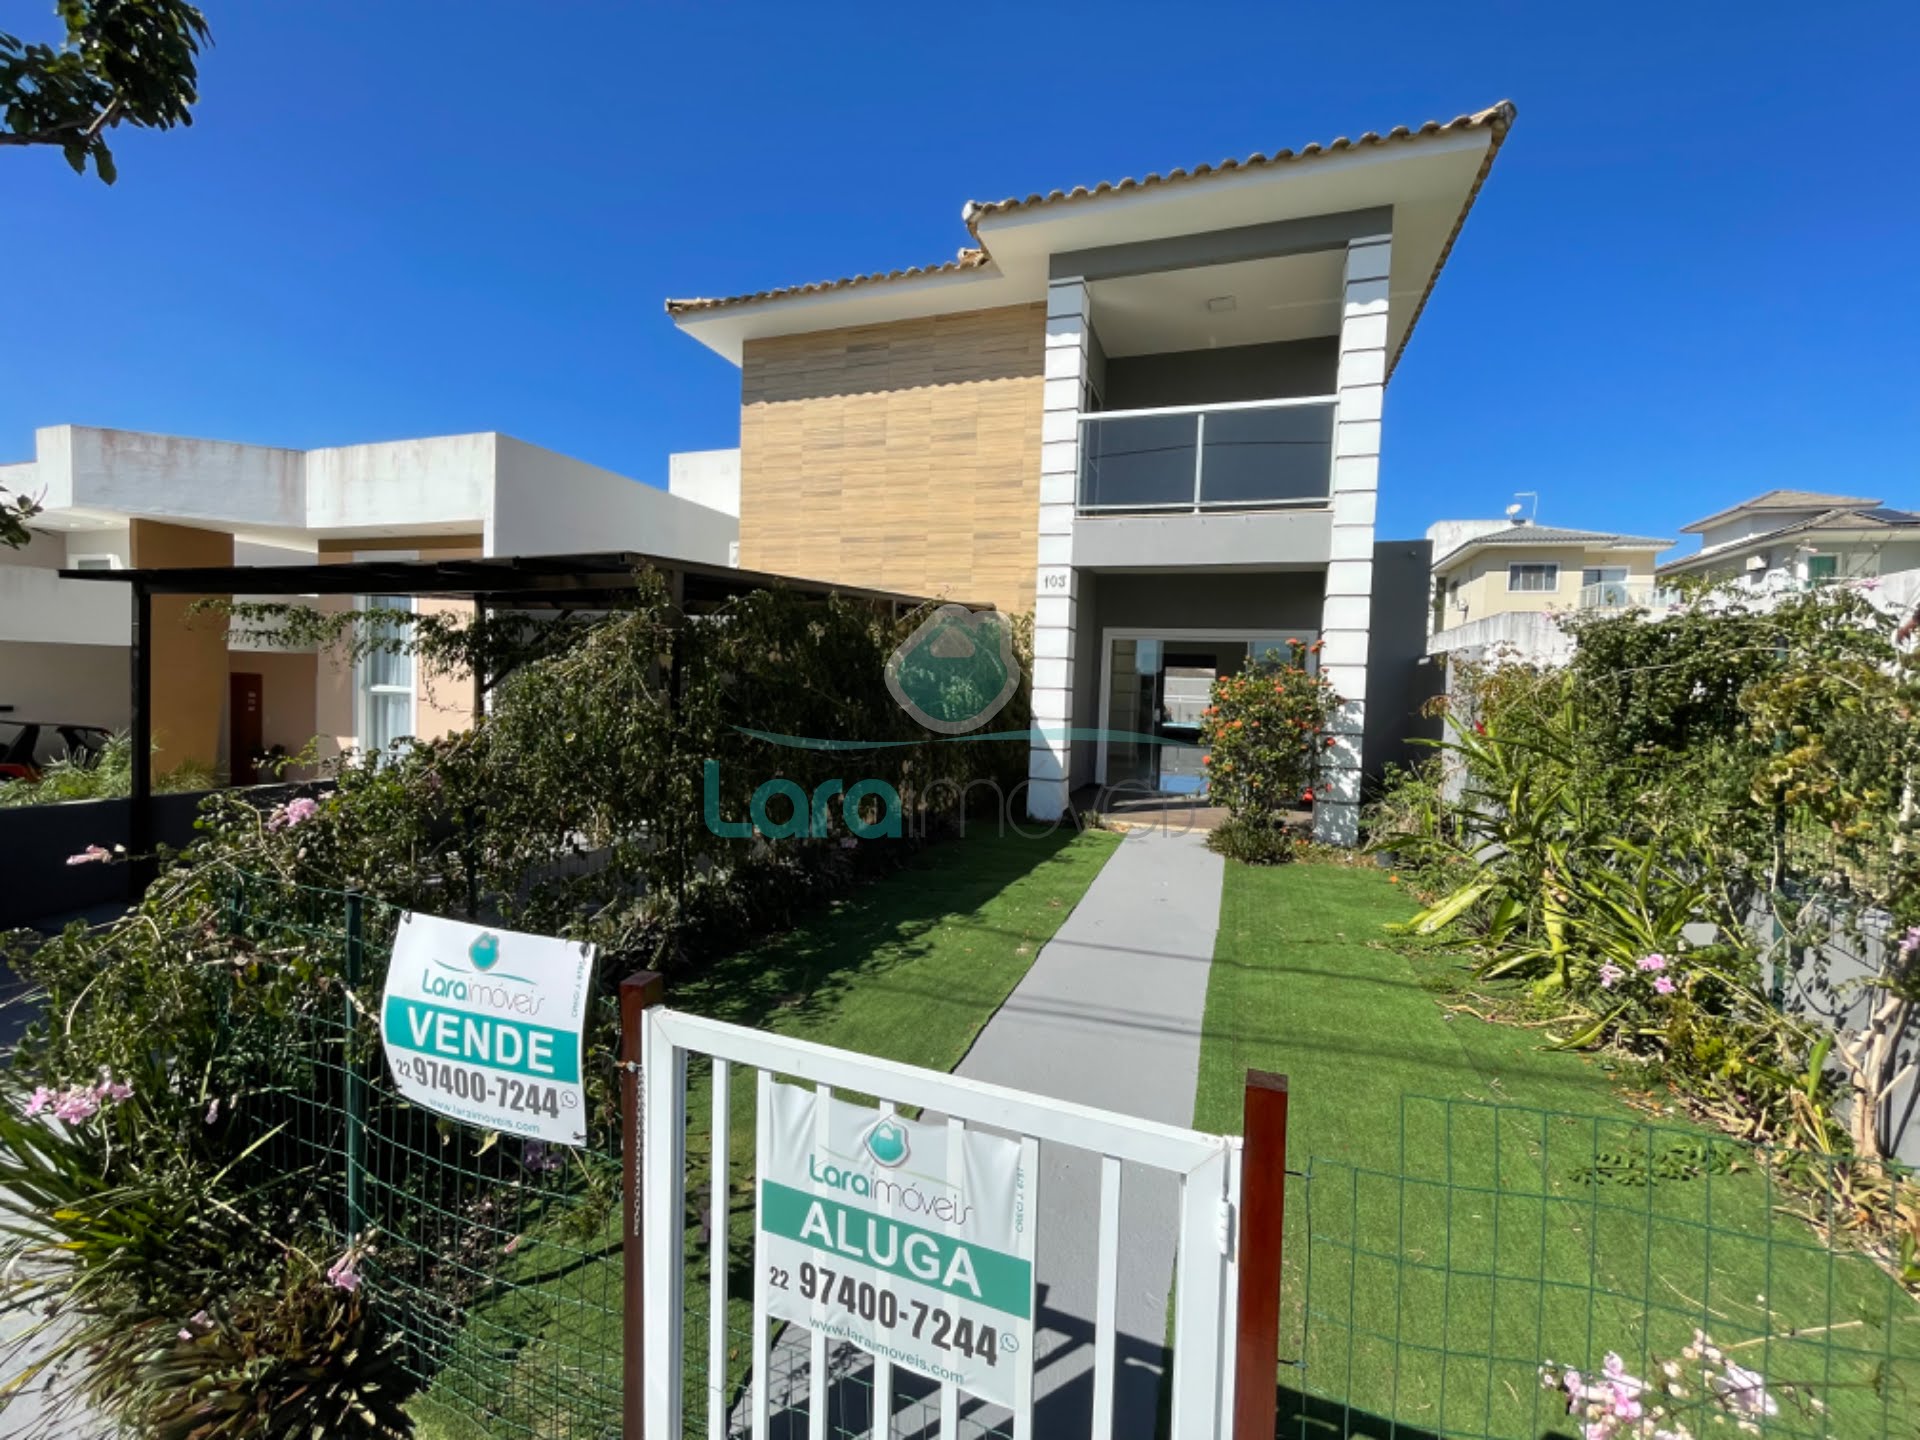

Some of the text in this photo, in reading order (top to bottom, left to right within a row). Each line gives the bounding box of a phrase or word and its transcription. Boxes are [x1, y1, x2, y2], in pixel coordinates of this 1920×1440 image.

[407, 1006, 555, 1074] VENDE
[395, 1056, 559, 1119] 22 97400-7244
[429, 1098, 540, 1134] www.laraimoveis.com
[799, 1200, 983, 1298] ALUGA
[769, 1261, 998, 1367] 22 97400-7244
[809, 1315, 965, 1385] www.laraimoveis.com
